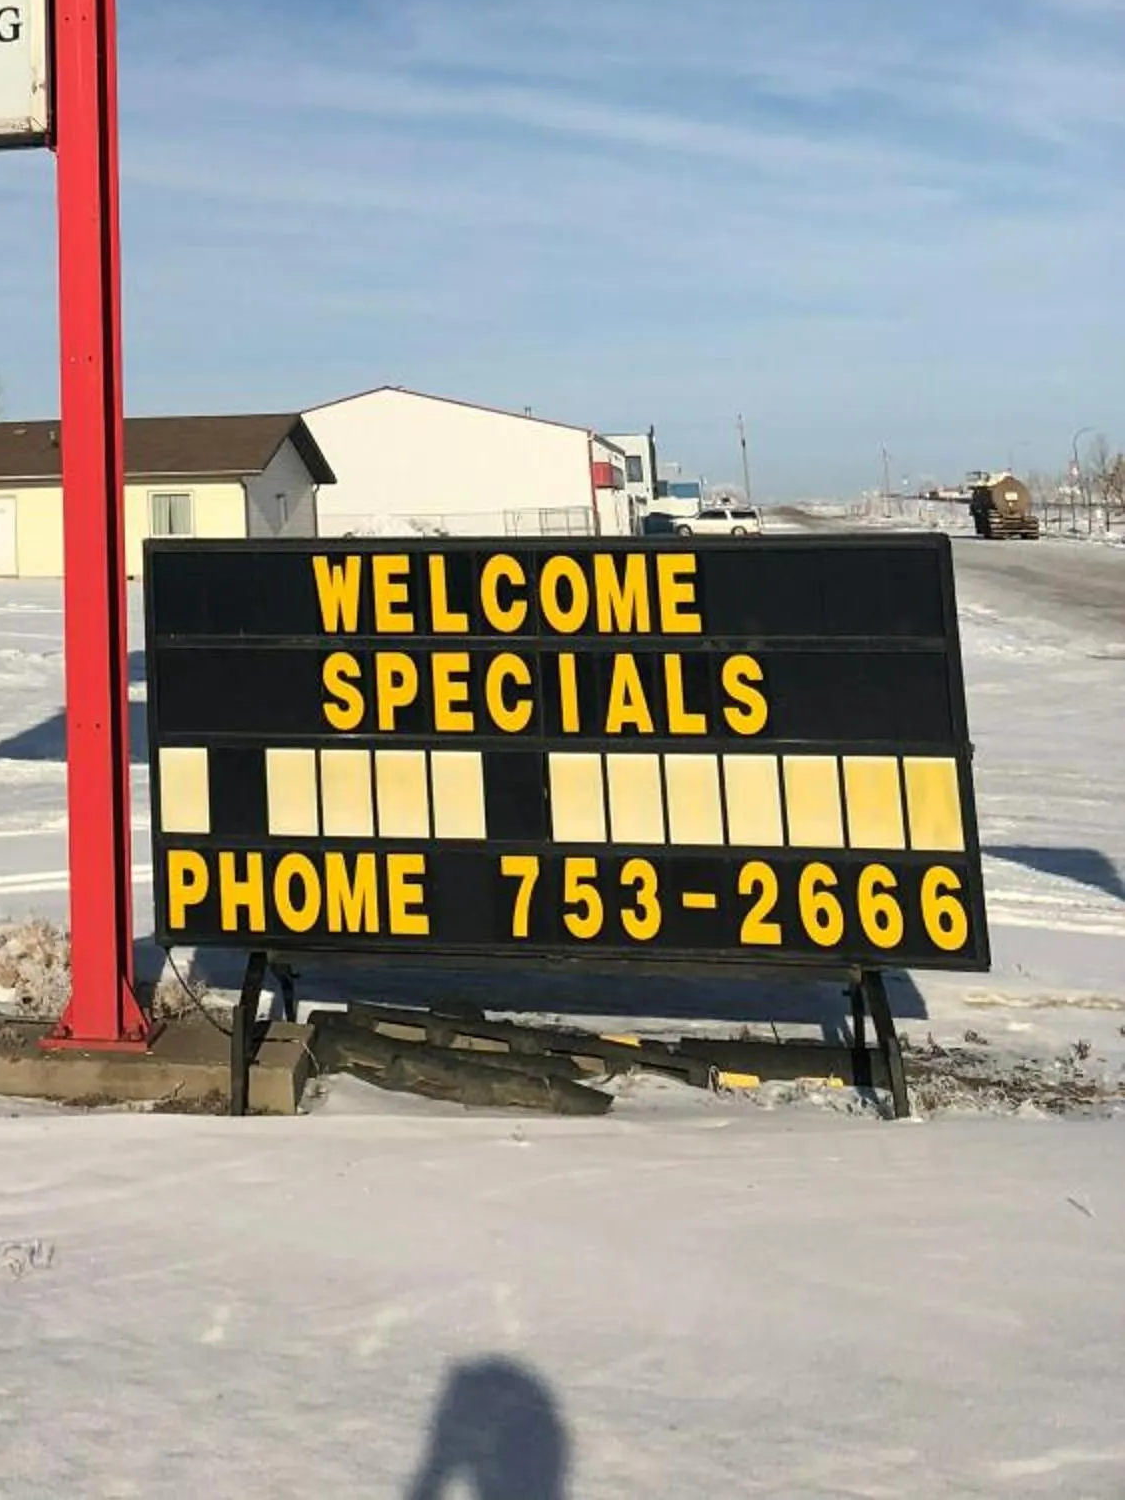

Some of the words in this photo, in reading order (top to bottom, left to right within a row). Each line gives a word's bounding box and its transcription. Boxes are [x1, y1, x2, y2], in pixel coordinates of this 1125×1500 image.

[313, 553, 702, 633] WELCOME
[322, 652, 768, 735] SPECIALS
[168, 849, 429, 935] PHOME
[501, 855, 968, 951] 753-2666
